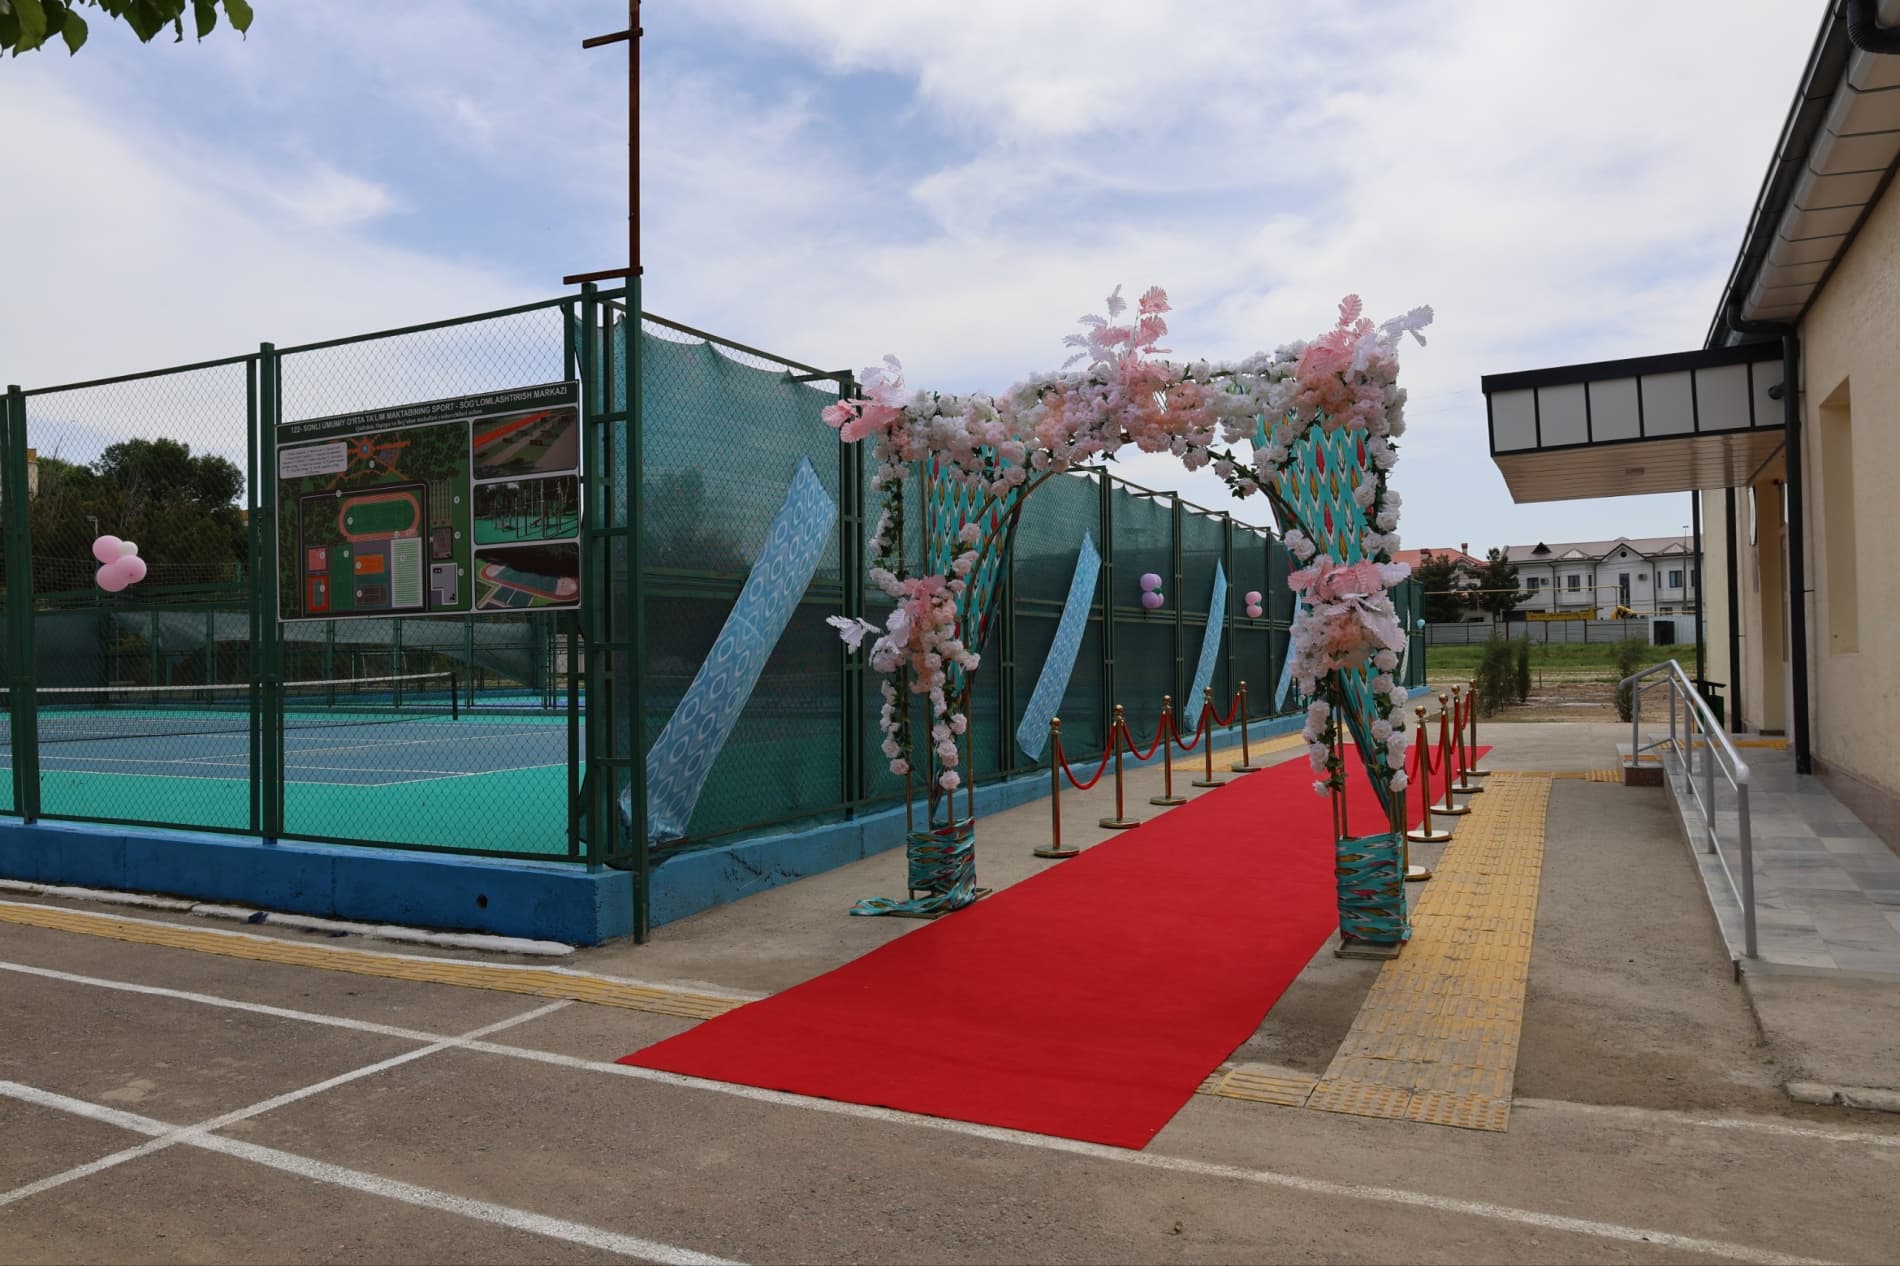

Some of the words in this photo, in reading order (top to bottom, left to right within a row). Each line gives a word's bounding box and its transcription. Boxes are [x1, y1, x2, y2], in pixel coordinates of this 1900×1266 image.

[303, 423, 321, 432] SONLI
[322, 418, 345, 430] UMUMIY
[386, 406, 431, 420] MAKTABINING
[431, 402, 454, 413] SPORT
[533, 386, 568, 399] MARKAZI
